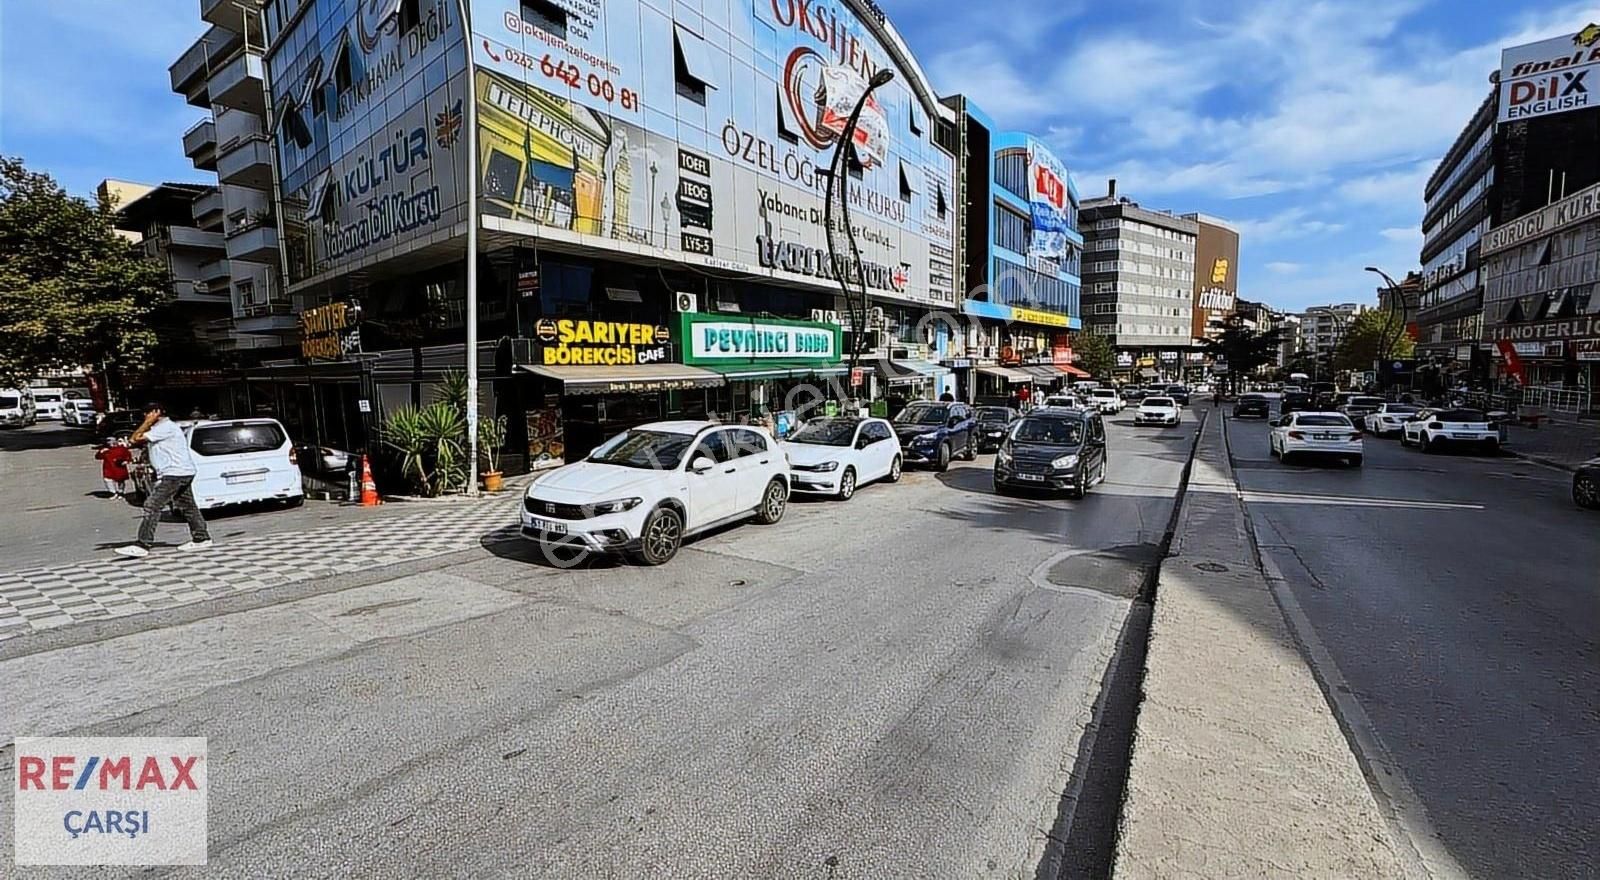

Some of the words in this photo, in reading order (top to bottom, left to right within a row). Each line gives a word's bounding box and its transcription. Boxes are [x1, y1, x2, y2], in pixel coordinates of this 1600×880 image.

[368, 45, 405, 94] HAYAL
[1511, 50, 1584, 77] final
[540, 54, 581, 89] 642
[587, 73, 615, 102] 00
[621, 87, 638, 112] 81
[1508, 94, 1588, 119] ENGLISH
[495, 86, 592, 158] TELEPHONE
[344, 127, 429, 202] KÜLTÜR
[681, 152, 708, 175] TOEFL
[722, 119, 779, 174] ÖZEL
[866, 186, 906, 223] KURSU
[683, 181, 708, 199] TEOG
[758, 188, 807, 221] Yabancı
[558, 319, 655, 345] SARIYER
[543, 343, 635, 366] BÖREKÇİSİ
